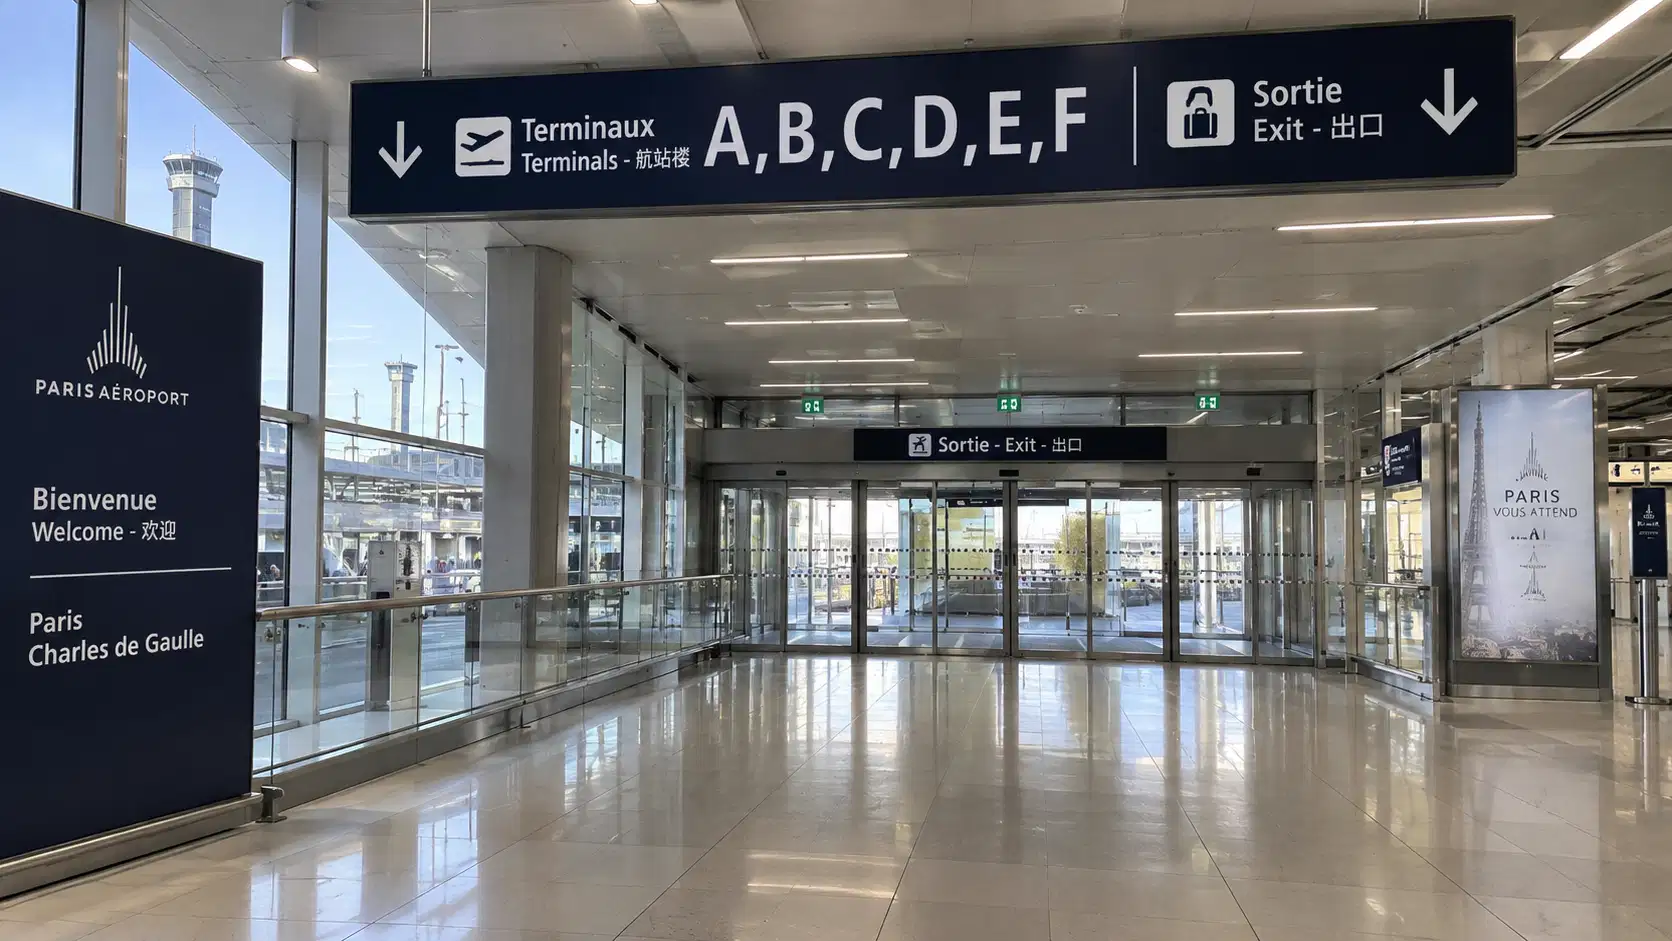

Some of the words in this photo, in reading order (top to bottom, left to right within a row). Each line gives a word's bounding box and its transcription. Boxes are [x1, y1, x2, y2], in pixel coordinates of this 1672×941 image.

[1253, 76, 1343, 107] Sortie
[521, 114, 655, 142] Terminaux
[1254, 117, 1304, 143] Exit
[1331, 113, 1383, 140] 出口
[521, 149, 618, 173] Terminals
[635, 146, 690, 170] 航站楼
[36, 378, 95, 399] PARIS
[98, 383, 190, 407] AÉROPORT
[938, 436, 990, 453] Sortie
[1005, 437, 1037, 453] Exit
[1052, 436, 1082, 453] 出口
[33, 486, 157, 511] Bienvenue
[1505, 489, 1560, 504] PARIS
[1493, 506, 1527, 518] VOUS
[1530, 507, 1578, 519] ATTEND
[31, 520, 124, 543] Welcome
[141, 519, 176, 541] 欢迎
[29, 609, 83, 635] Paris
[28, 638, 109, 667] Charles
[114, 635, 139, 658] de
[145, 628, 204, 654] Gaulle
